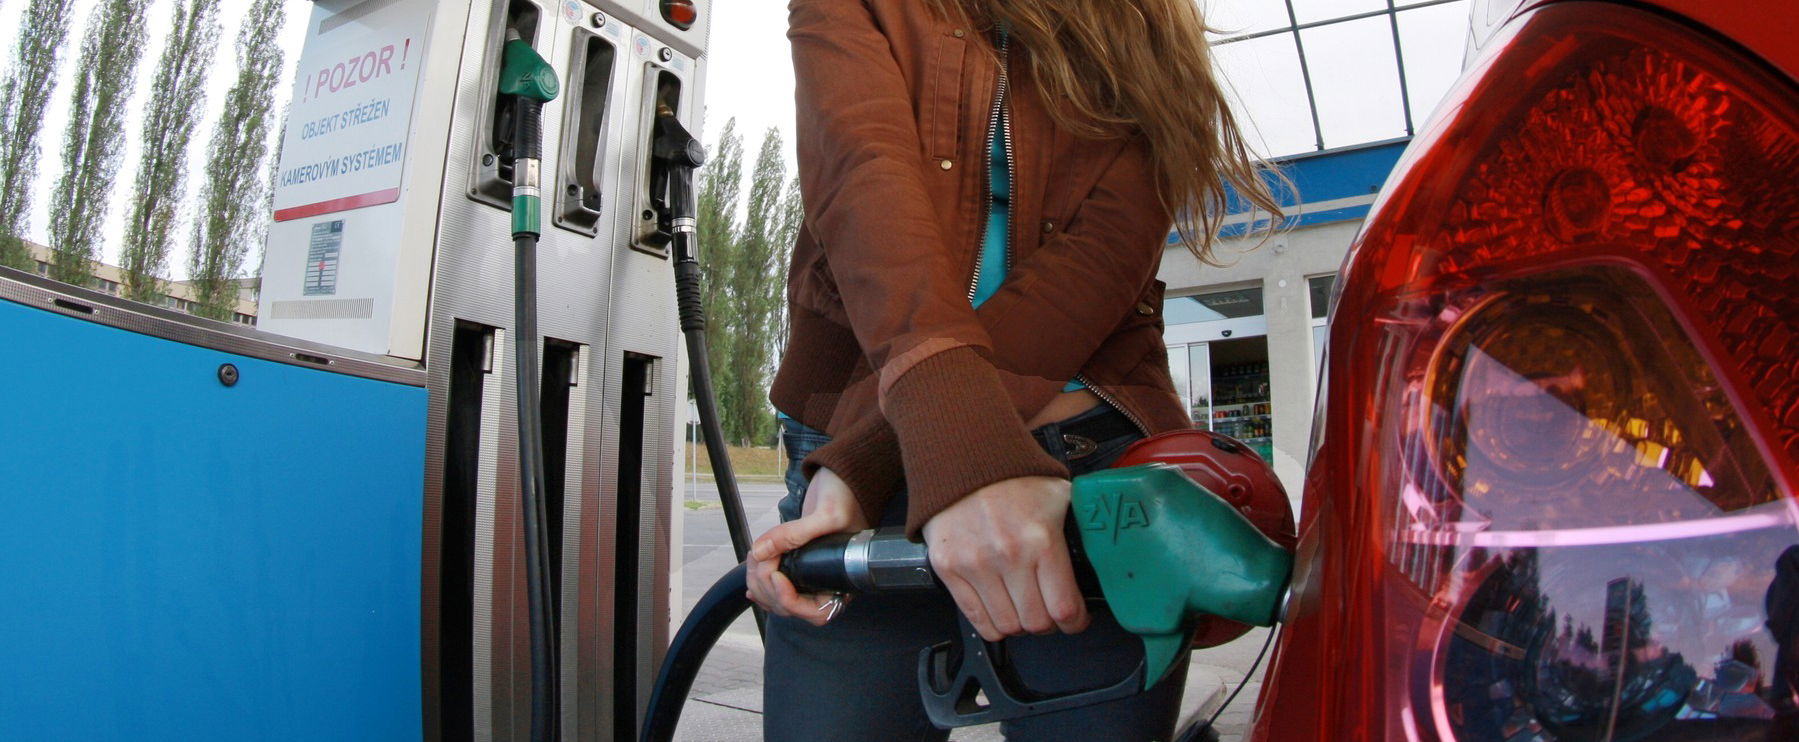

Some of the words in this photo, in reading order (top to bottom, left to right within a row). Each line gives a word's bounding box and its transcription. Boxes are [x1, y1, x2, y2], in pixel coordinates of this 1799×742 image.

[303, 74, 311, 103] !
[314, 44, 395, 99] POZOR
[400, 38, 411, 70] !
[302, 113, 340, 140] OBJEKT
[340, 98, 391, 129] STŘEŽEN
[280, 155, 340, 188] KAMEROVÝM
[341, 142, 403, 175] SYSTÉMEM
